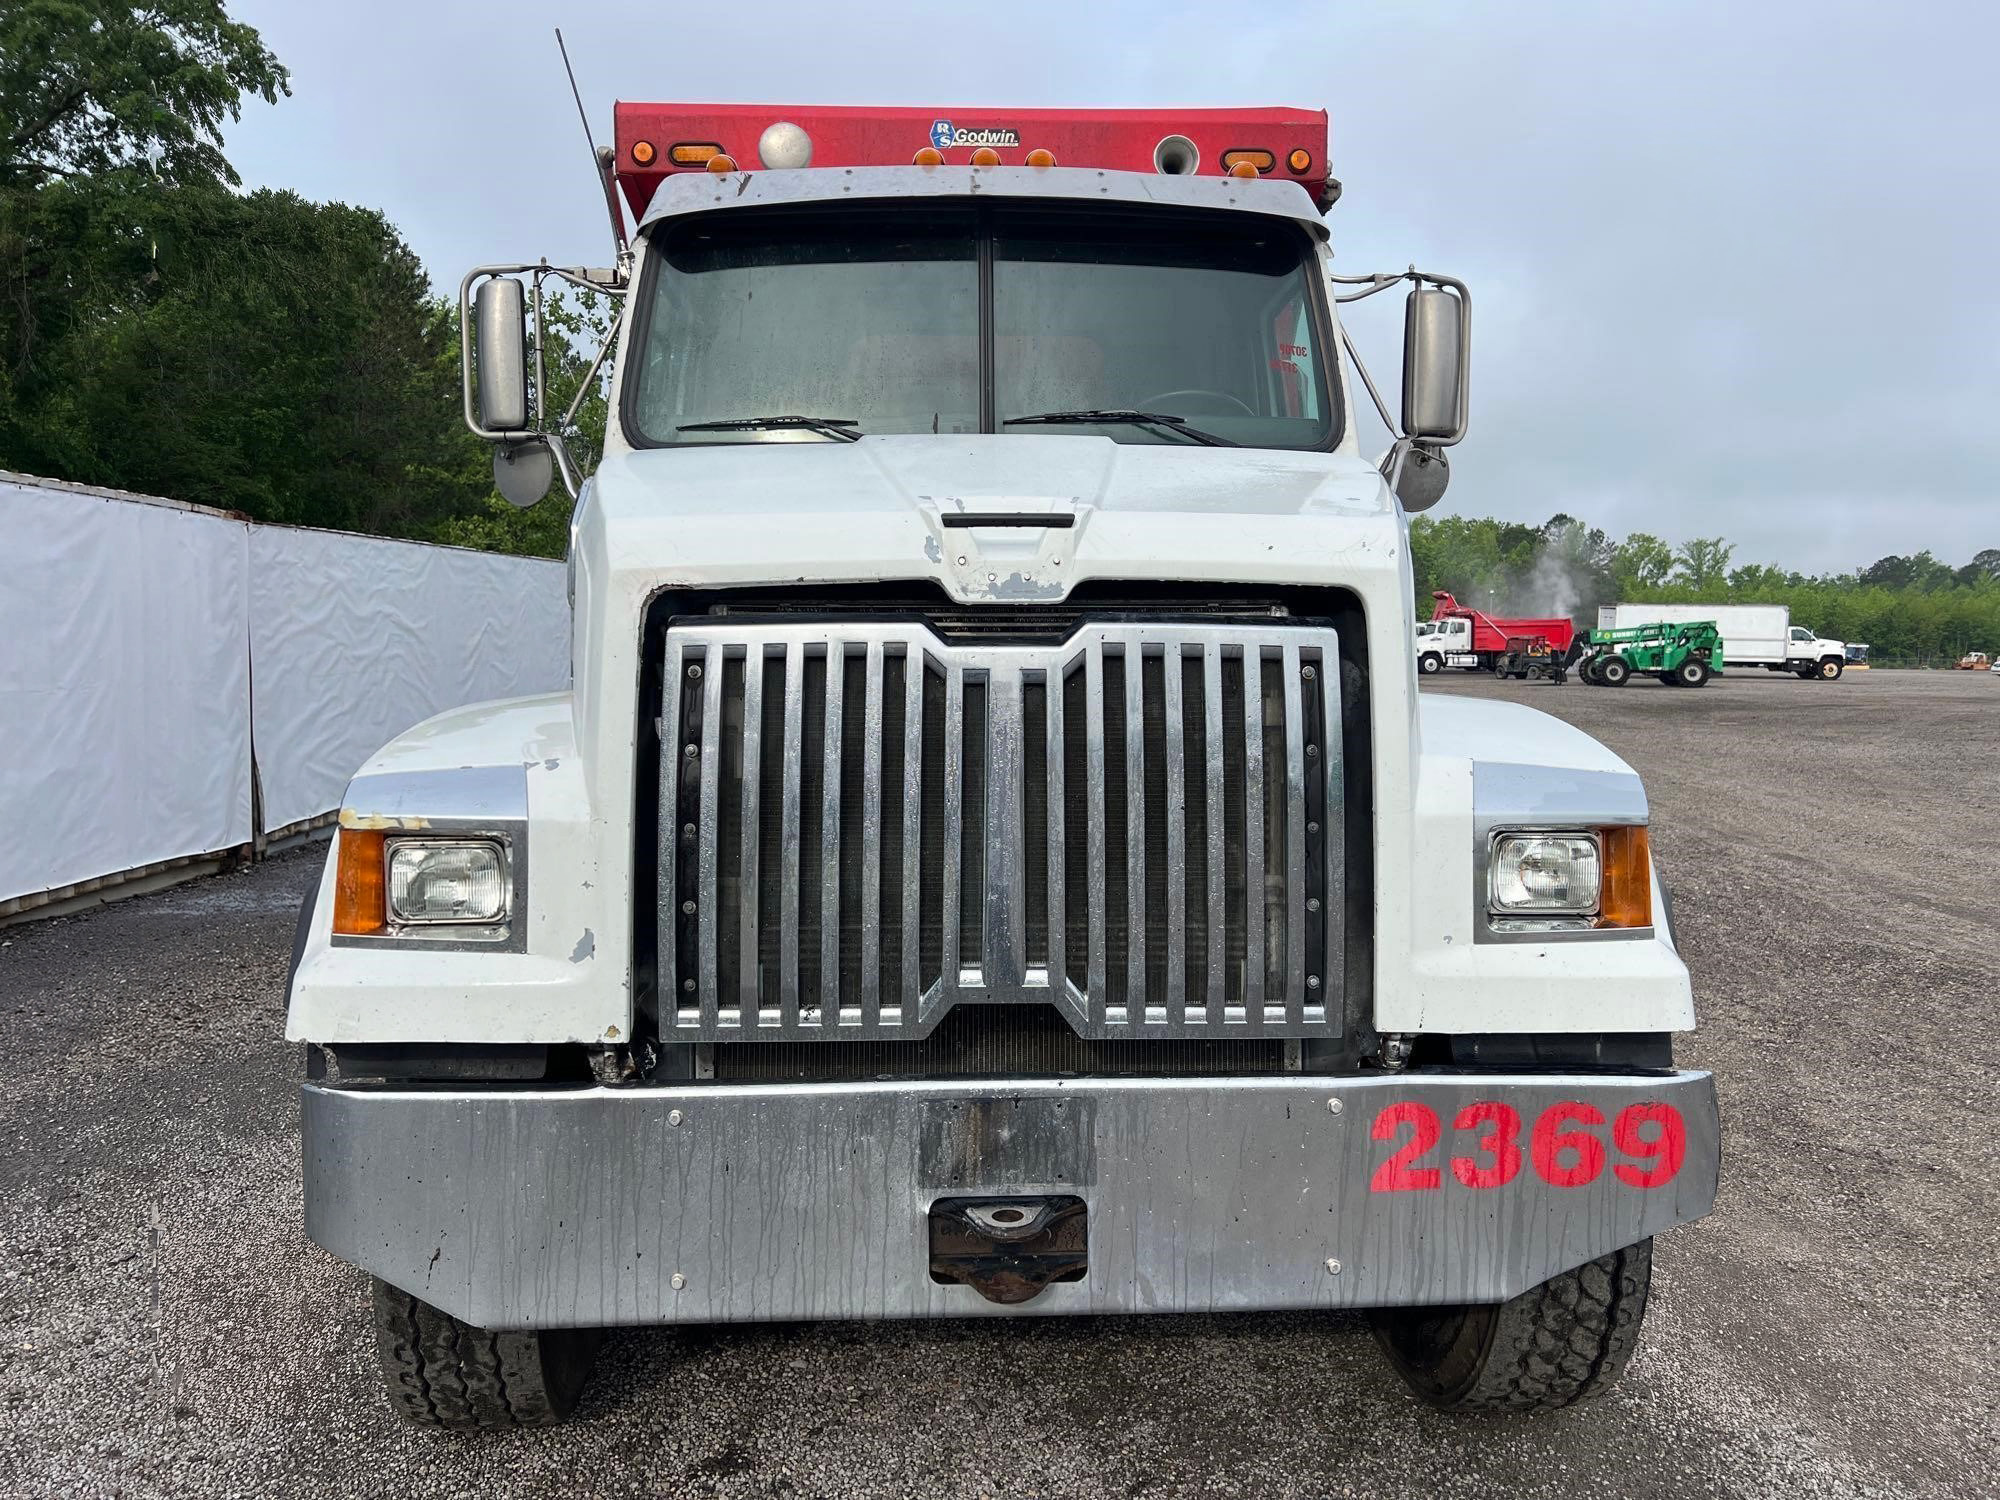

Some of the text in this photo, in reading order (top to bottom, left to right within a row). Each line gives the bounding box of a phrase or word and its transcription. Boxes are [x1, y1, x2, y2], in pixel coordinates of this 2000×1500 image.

[936, 122, 950, 134] R
[939, 135, 951, 147] S
[955, 128, 1015, 143] Godwin
[1370, 1101, 1686, 1192] 2369
